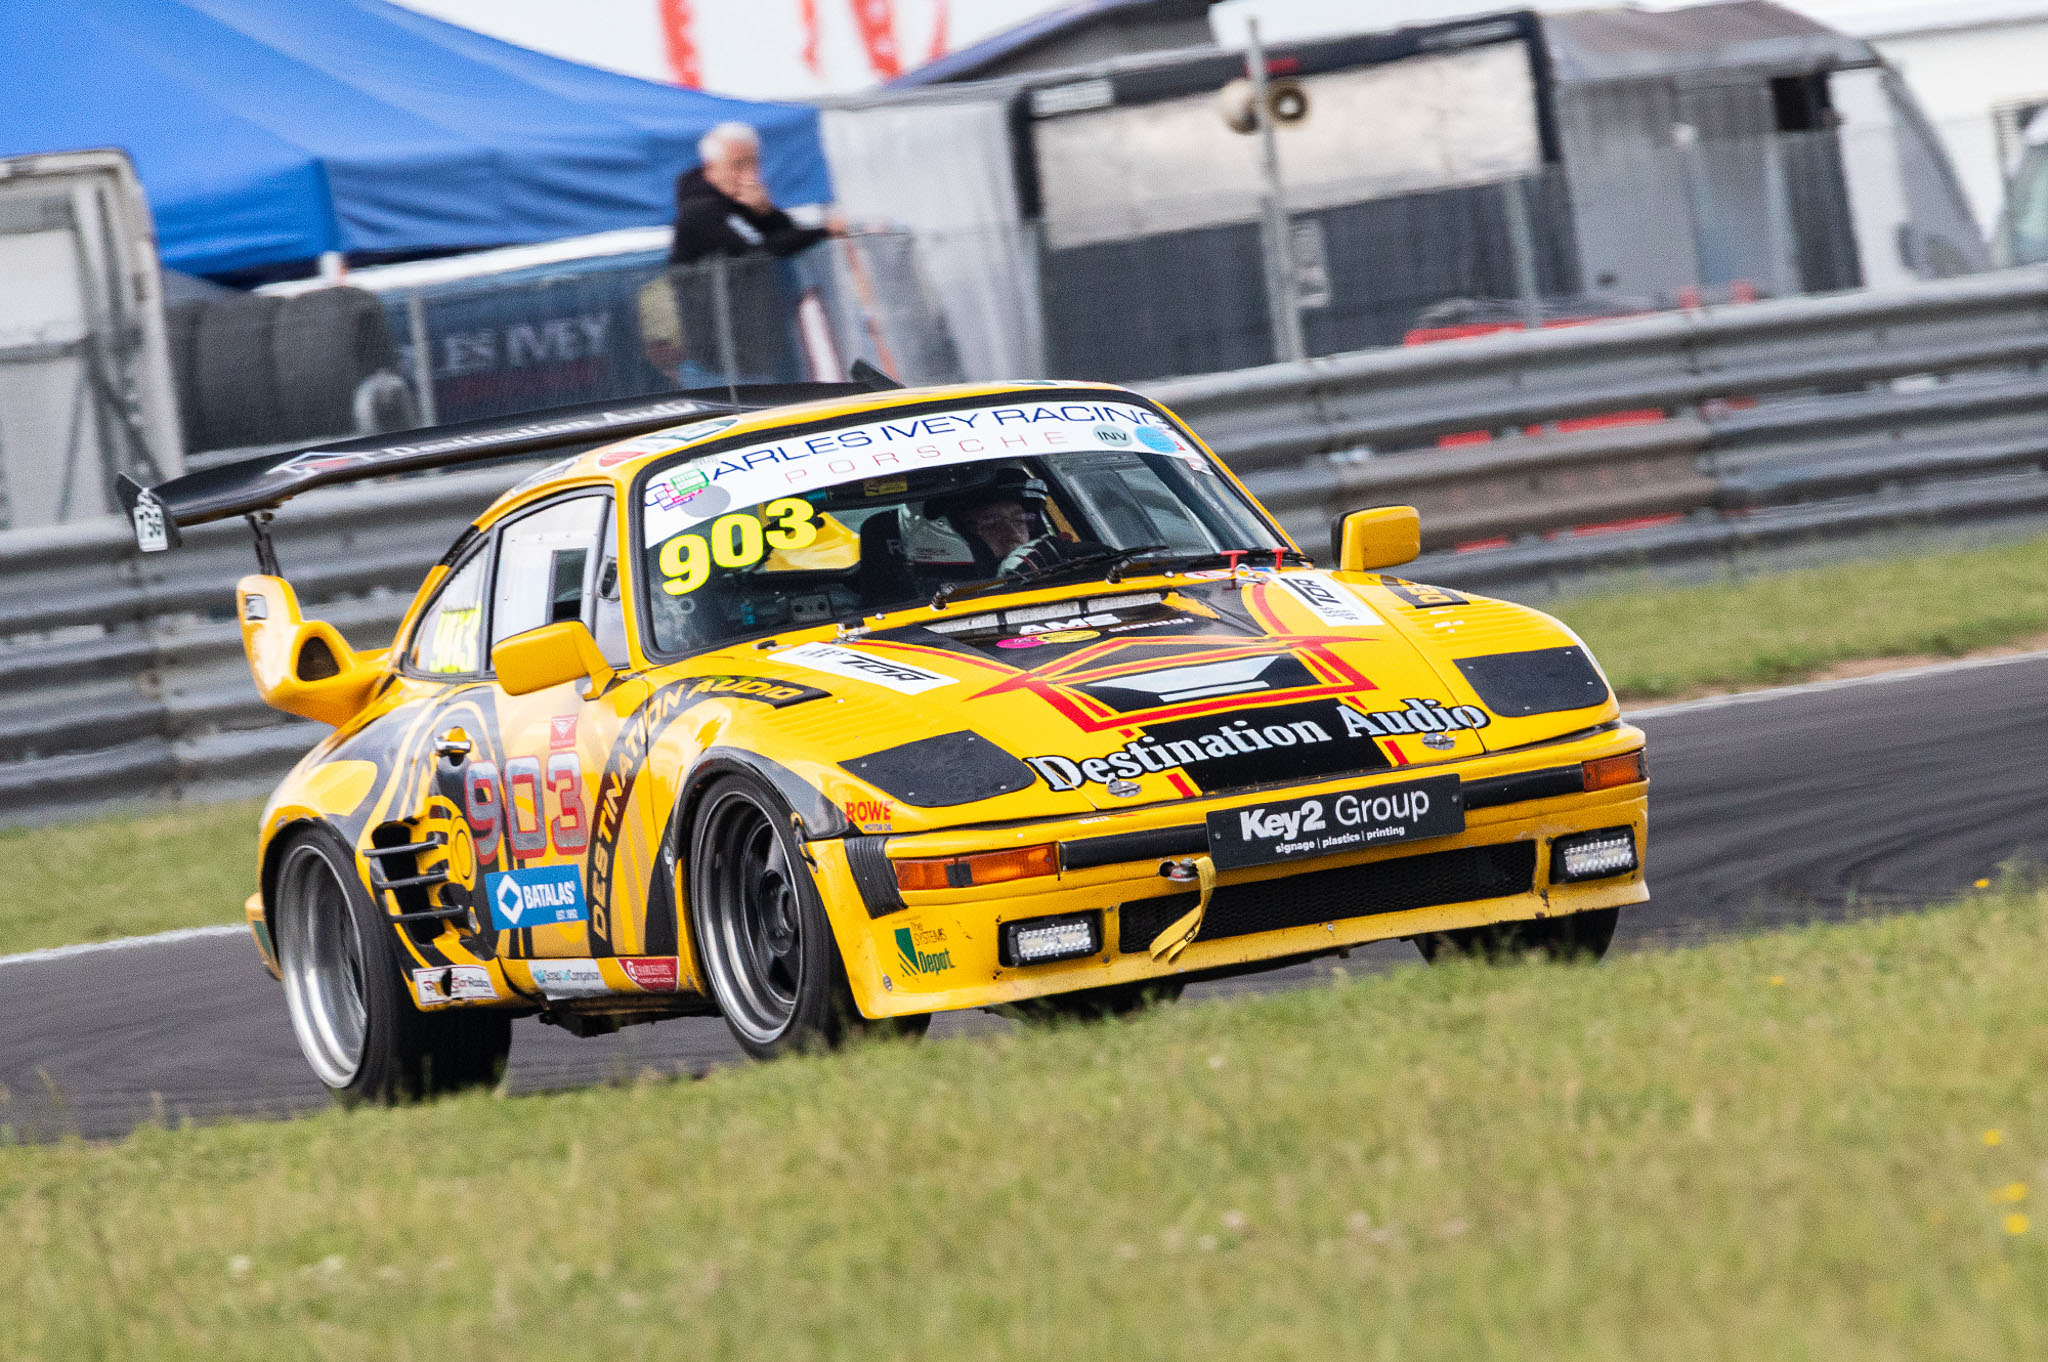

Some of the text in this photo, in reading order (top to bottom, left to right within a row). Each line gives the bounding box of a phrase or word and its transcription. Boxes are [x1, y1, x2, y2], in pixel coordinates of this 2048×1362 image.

[880, 412, 979, 442] IVEY
[1097, 430, 1128, 442] INV
[784, 431, 1069, 485] PORSCHE
[658, 497, 818, 596] 903
[1019, 613, 1122, 636] AMS
[1024, 697, 1490, 792] Destination Audio
[464, 750, 590, 866] 903
[592, 678, 804, 943] DESTINATION AUDIO
[845, 799, 895, 823] ROWE
[1239, 790, 1431, 841] Key2 Group
[1275, 825, 1405, 855] signage plastics printing
[917, 947, 957, 976] Depot
